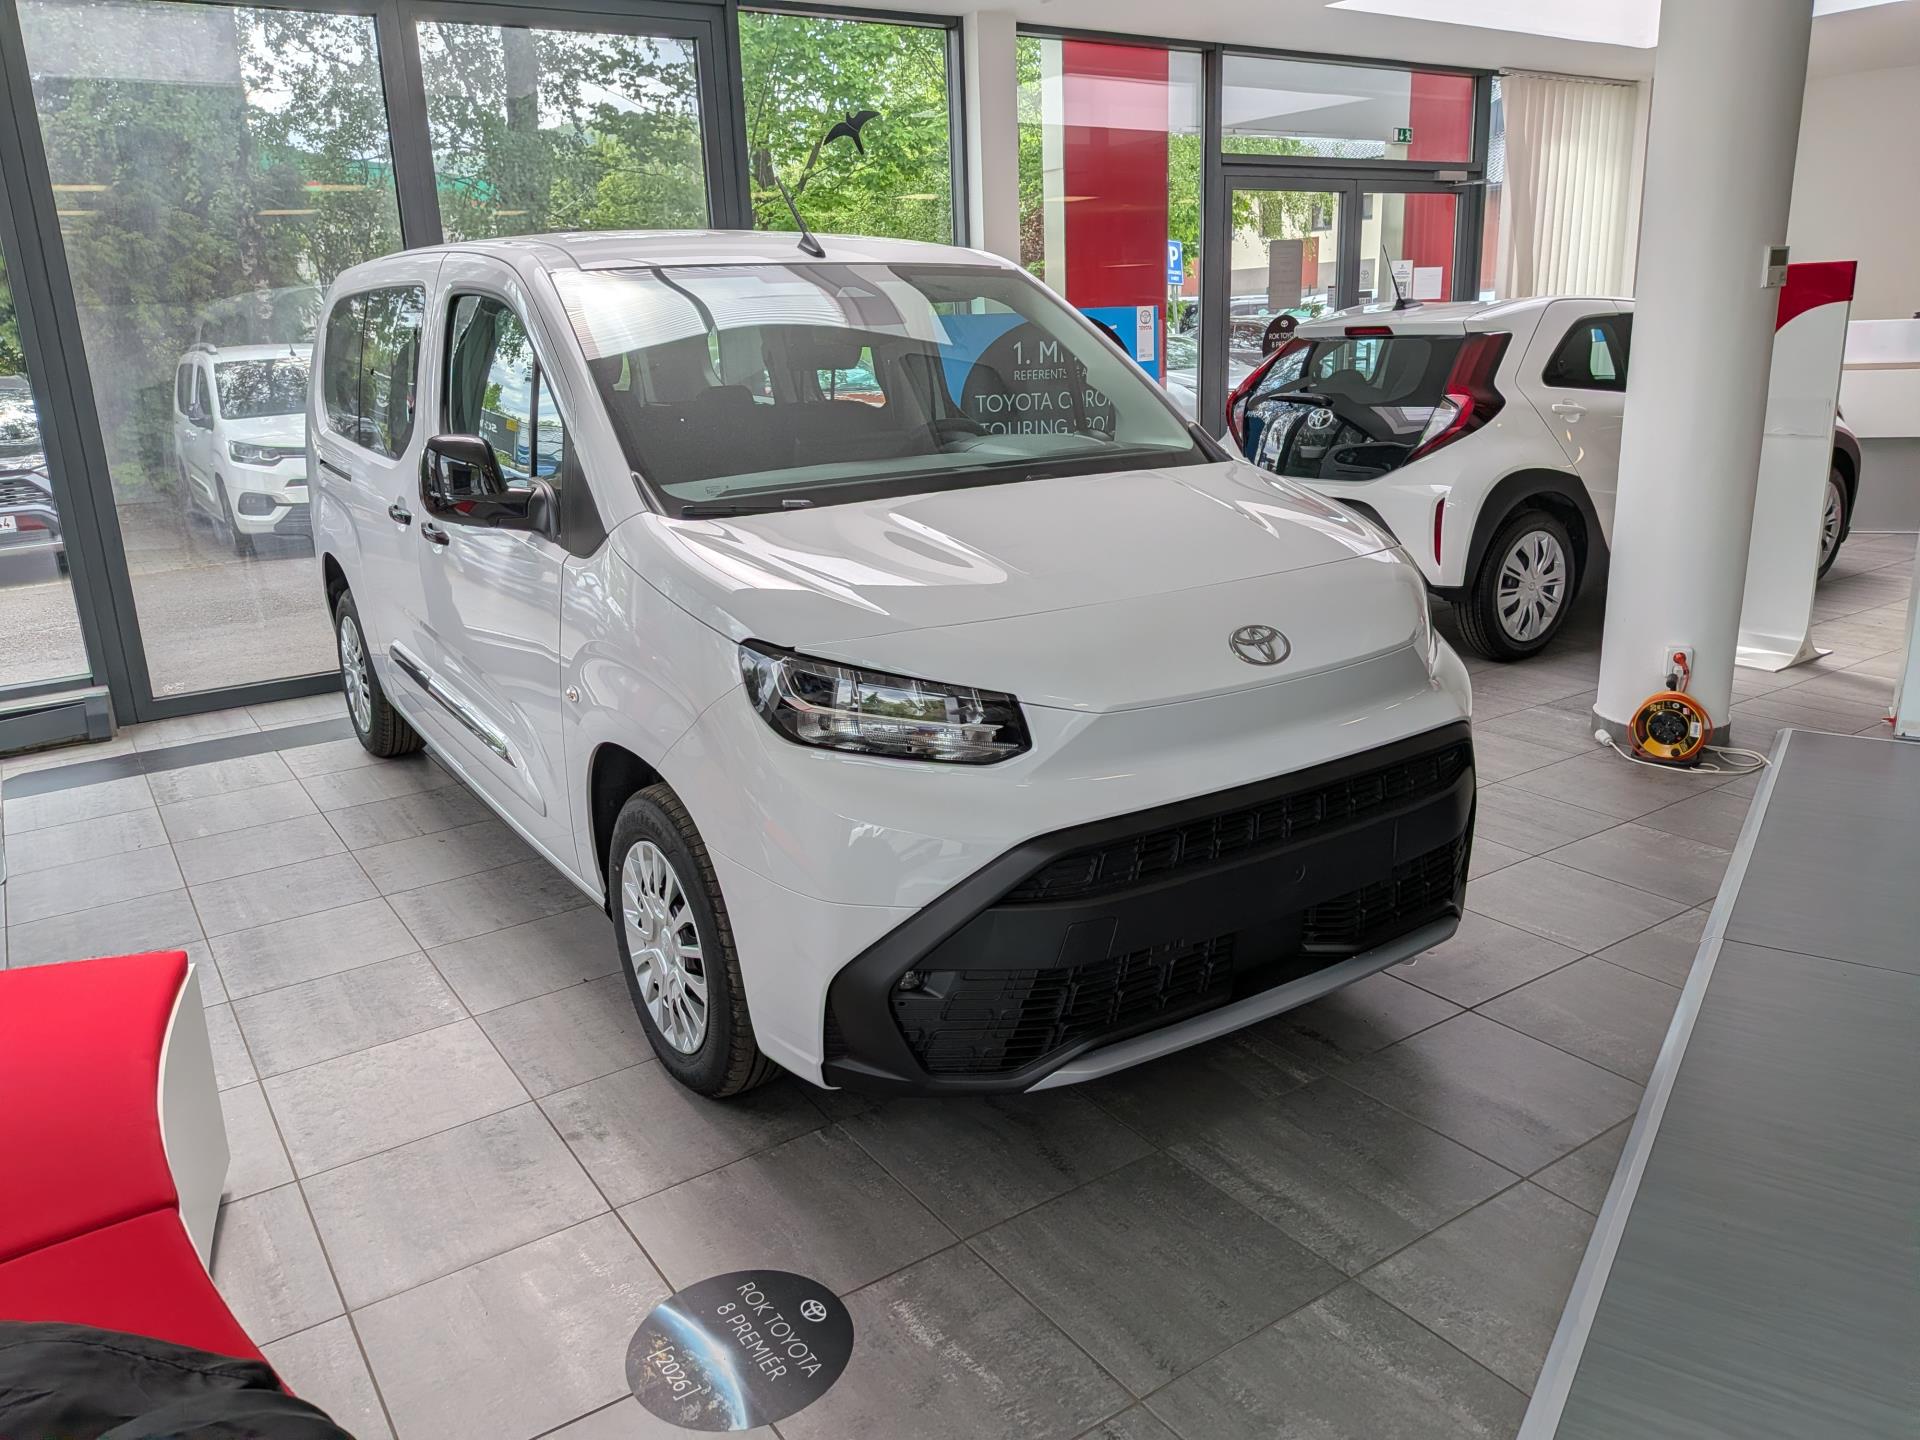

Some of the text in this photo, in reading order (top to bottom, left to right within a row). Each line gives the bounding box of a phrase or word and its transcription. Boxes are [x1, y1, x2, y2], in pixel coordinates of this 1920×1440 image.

[1168, 246, 1179, 268] P
[1013, 340, 1031, 365] 1.
[975, 392, 1052, 414] TOYOTA
[717, 1301, 787, 1382] 8 PREMIÉR
[736, 1281, 823, 1378] ROK TOYOTA
